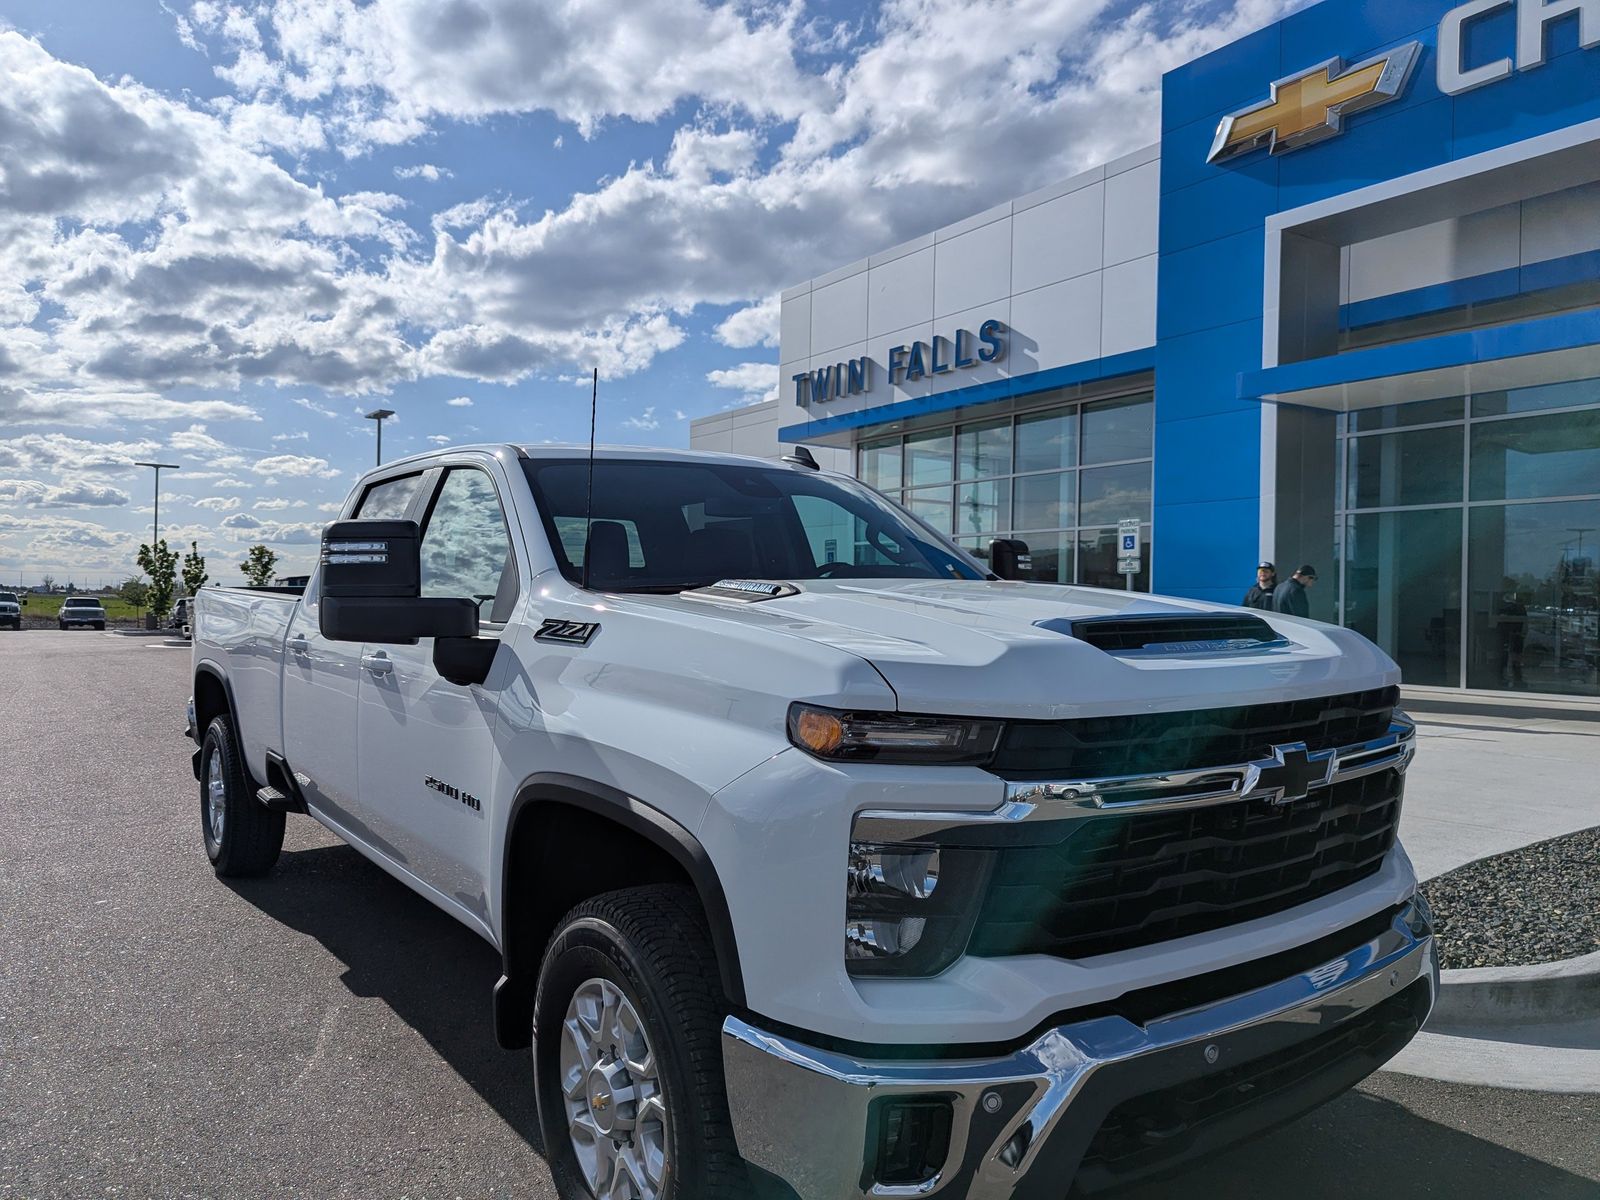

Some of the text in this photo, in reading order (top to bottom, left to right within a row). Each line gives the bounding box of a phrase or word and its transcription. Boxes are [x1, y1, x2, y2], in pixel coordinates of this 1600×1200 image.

[792, 319, 1007, 408] TWIN FALLS
[533, 618, 601, 645] Z71
[425, 774, 481, 812] 2500 HD
